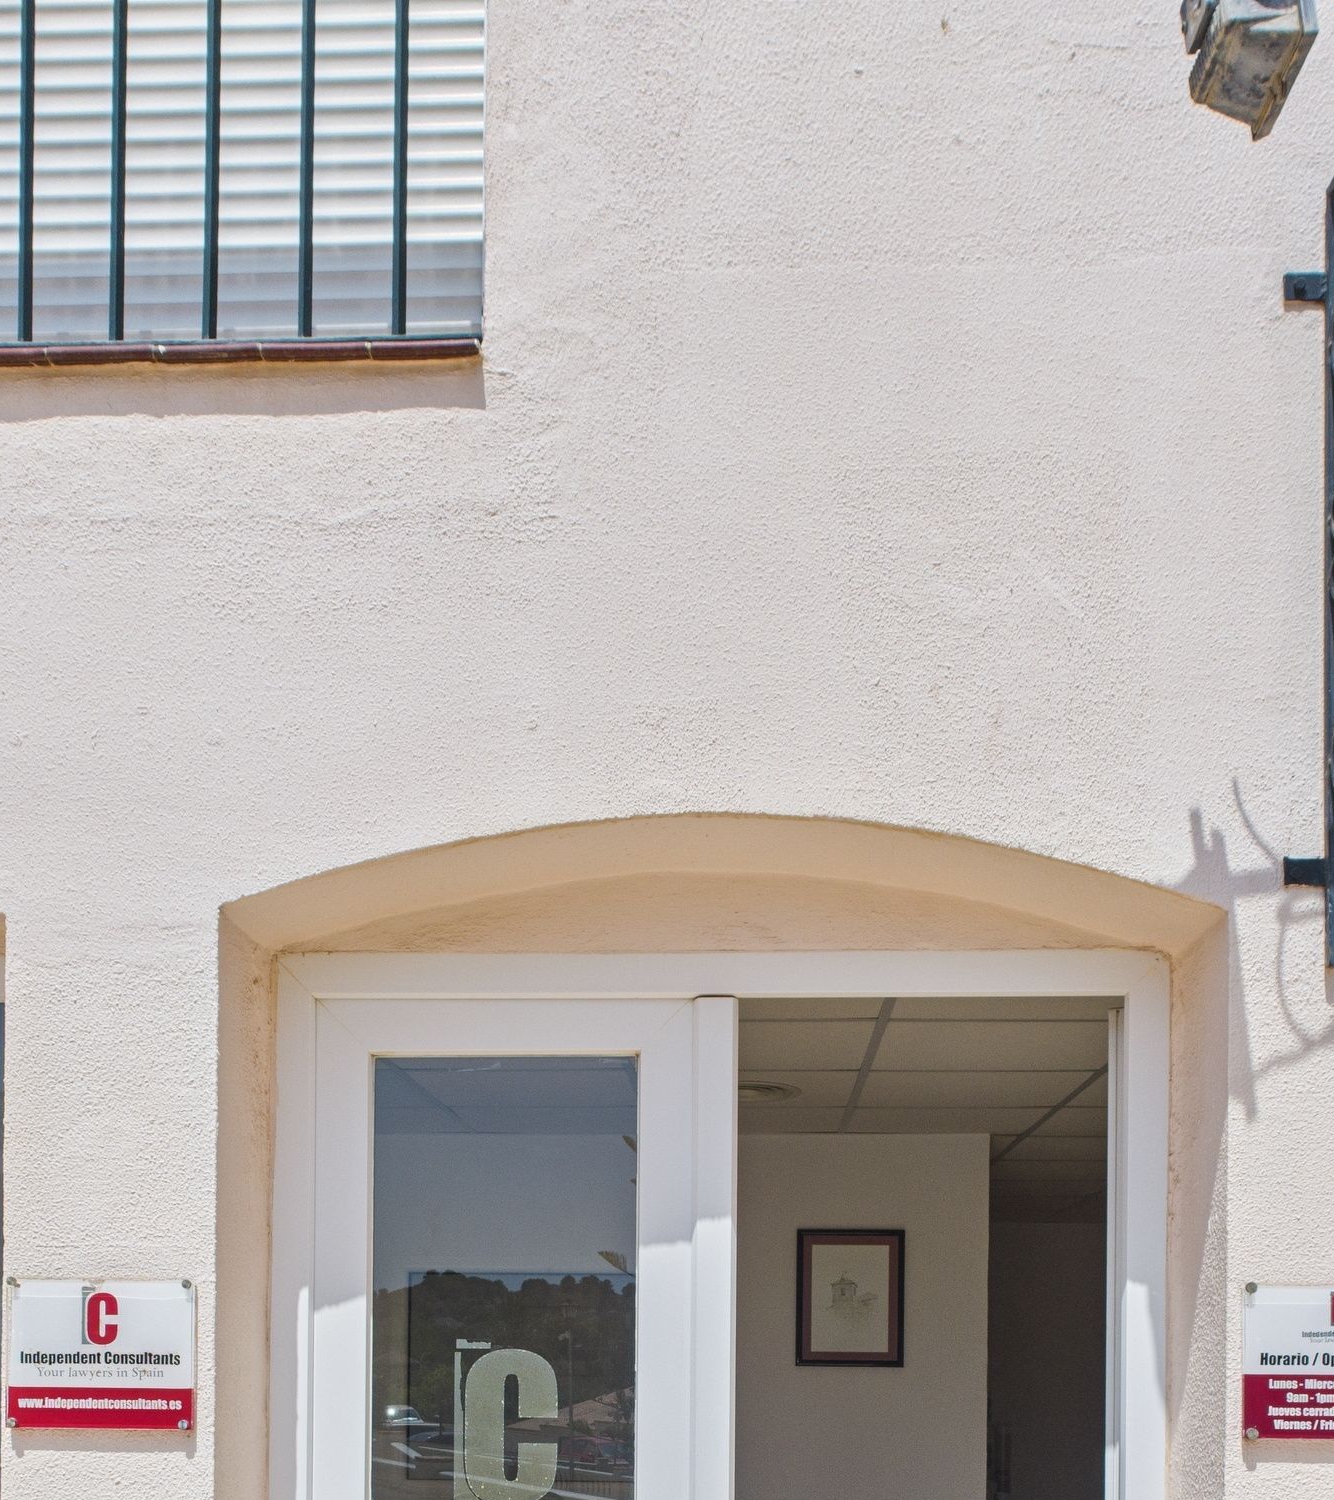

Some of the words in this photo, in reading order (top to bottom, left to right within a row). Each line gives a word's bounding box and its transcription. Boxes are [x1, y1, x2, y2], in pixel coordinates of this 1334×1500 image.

[20, 1351, 101, 1366] Independent
[104, 1351, 181, 1366] Consultants
[1260, 1352, 1309, 1366] Horario
[1312, 1352, 1319, 1366] /
[37, 1366, 65, 1378] Your
[68, 1366, 113, 1381] lawyers
[117, 1366, 128, 1378] in
[132, 1367, 164, 1381] Spain
[1268, 1379, 1298, 1390] Lunes
[17, 1397, 183, 1411] www.independentconsultants.es
[1286, 1392, 1309, 1403] 9am
[1267, 1406, 1302, 1417] Jueves
[1274, 1419, 1312, 1430] Viernes
[1313, 1420, 1319, 1431] /
